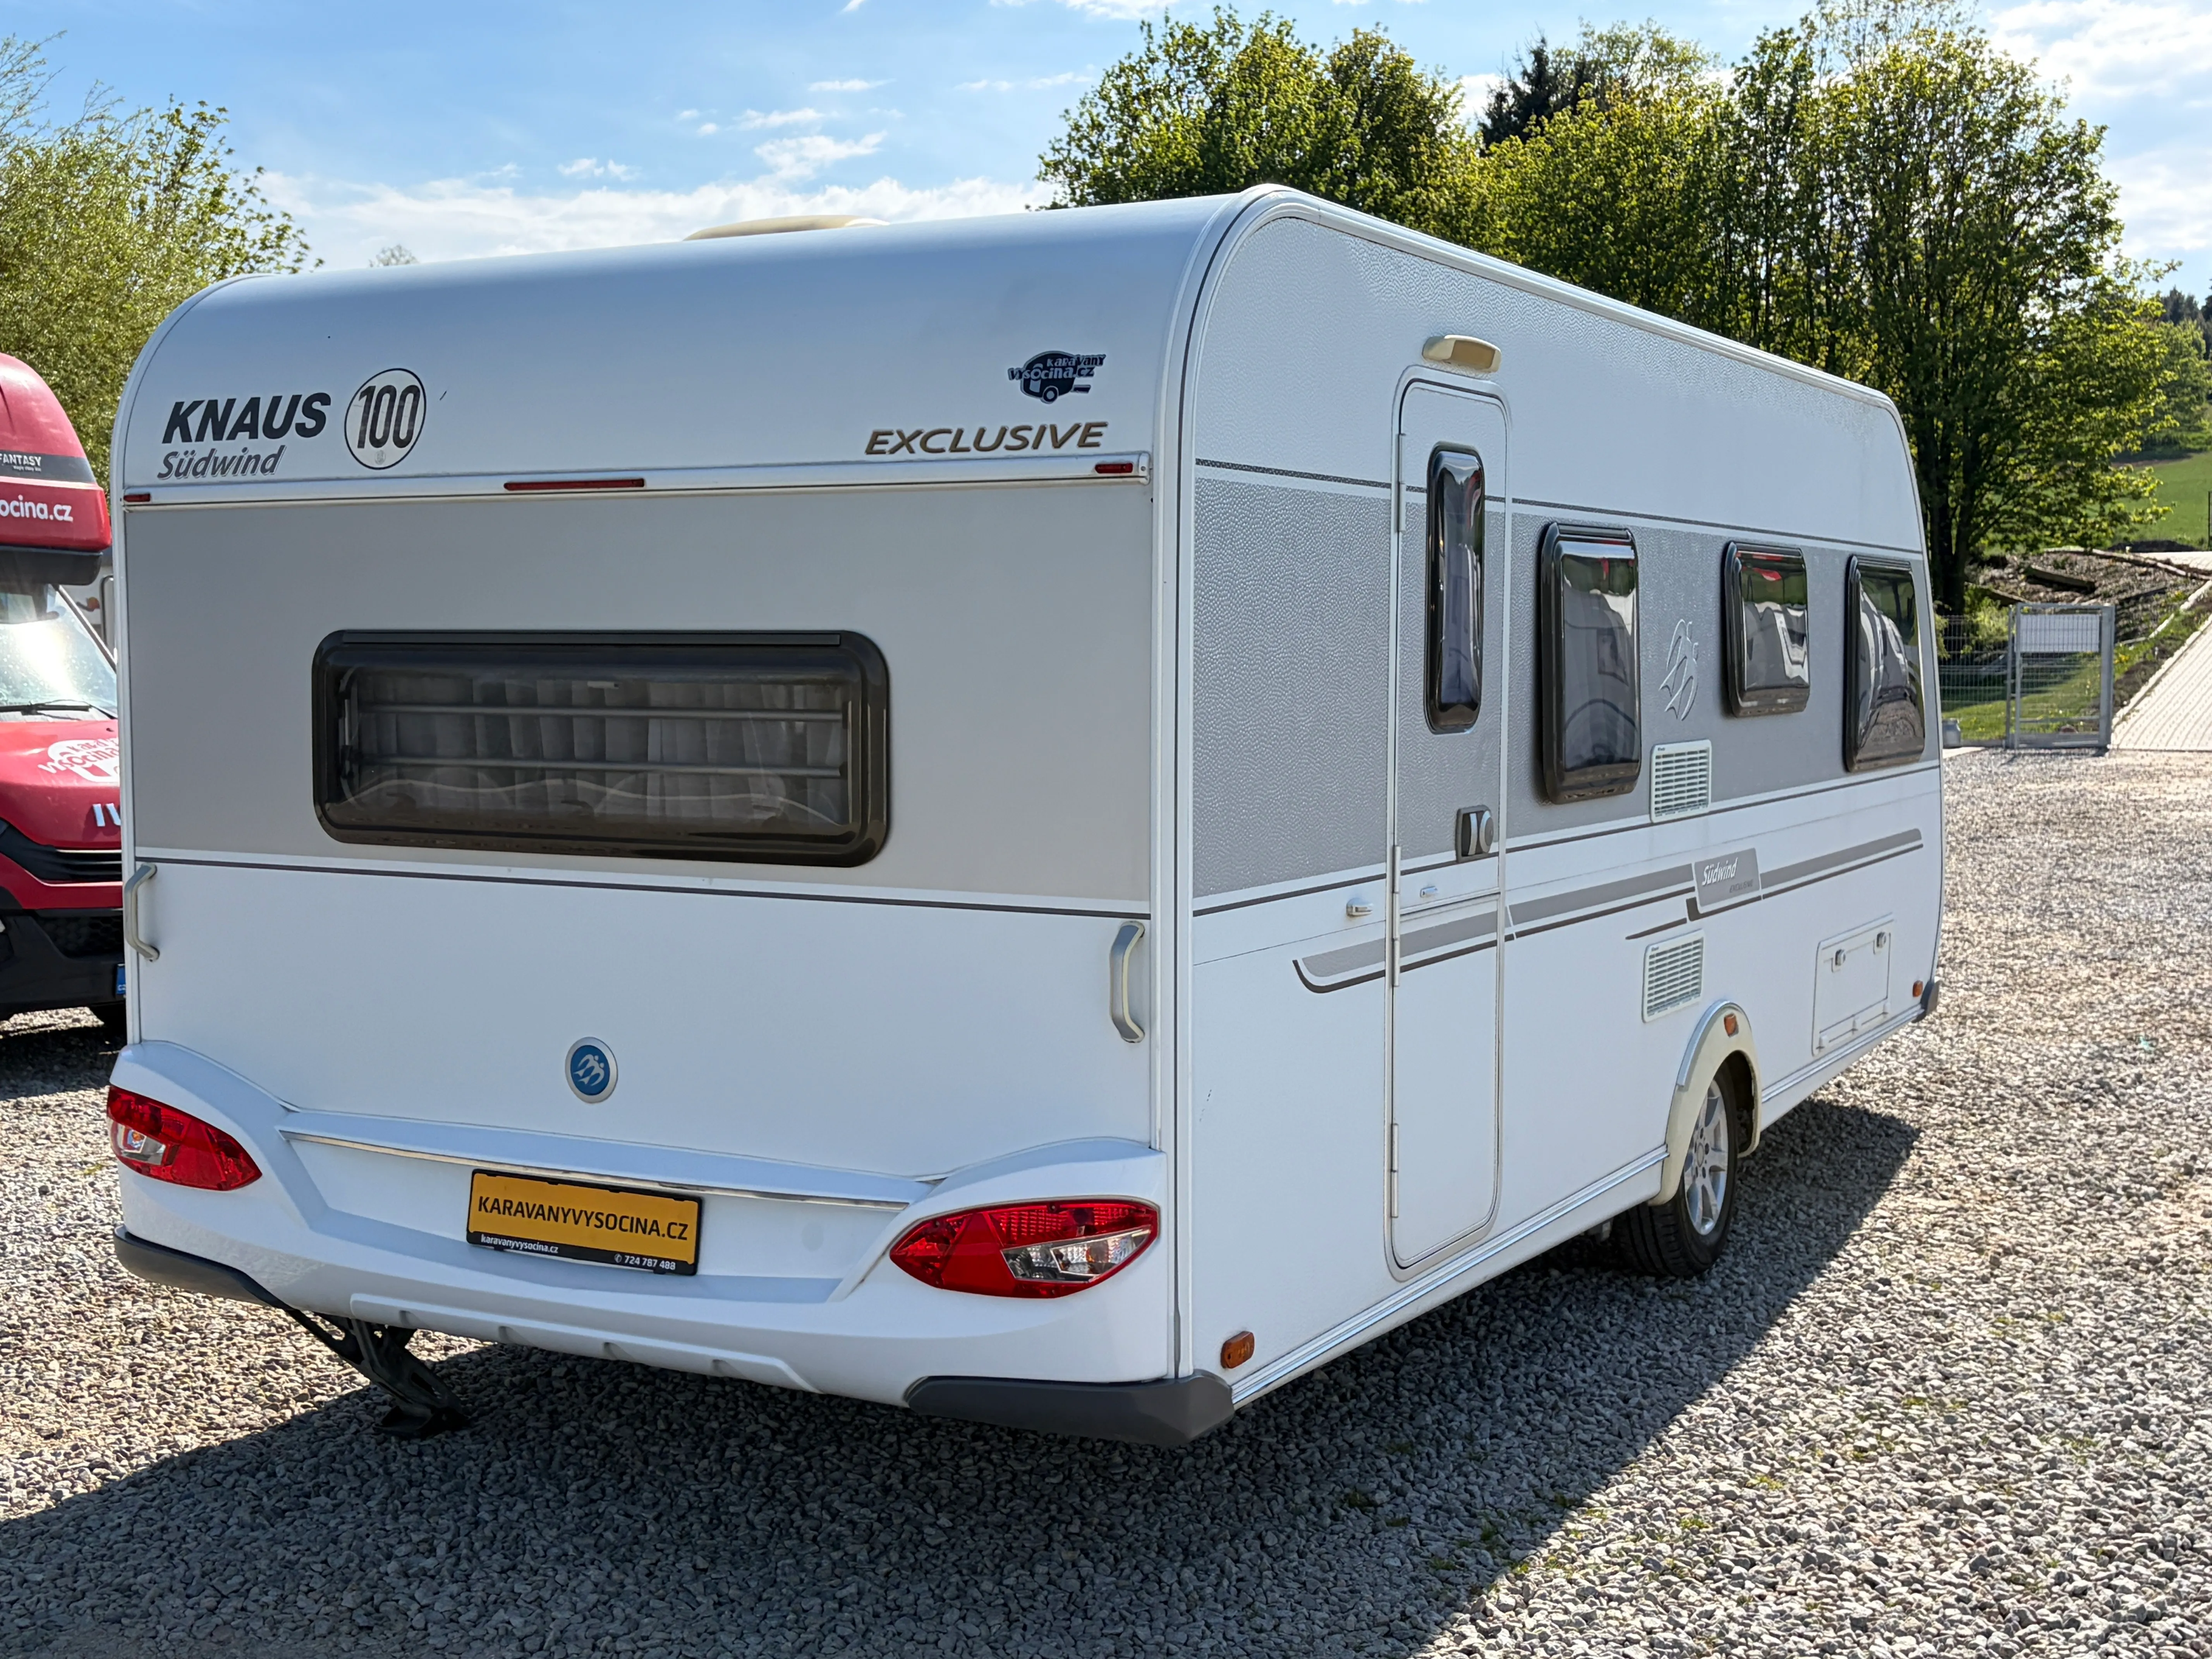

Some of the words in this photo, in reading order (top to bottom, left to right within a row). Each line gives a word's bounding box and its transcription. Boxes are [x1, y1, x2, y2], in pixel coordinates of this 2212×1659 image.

[162, 392, 331, 444] KNAUS
[357, 385, 420, 448] 100
[865, 421, 1108, 455] EXCLUSIVE
[157, 445, 287, 479] Südwind
[1702, 857, 1738, 886] Südwind
[478, 1196, 688, 1240] KARAVANYVYSOCINA.CZ
[481, 1234, 559, 1254] karavanyvysocina.cz
[624, 1255, 640, 1265] 724
[642, 1257, 658, 1267] 787
[659, 1260, 676, 1271] 488
